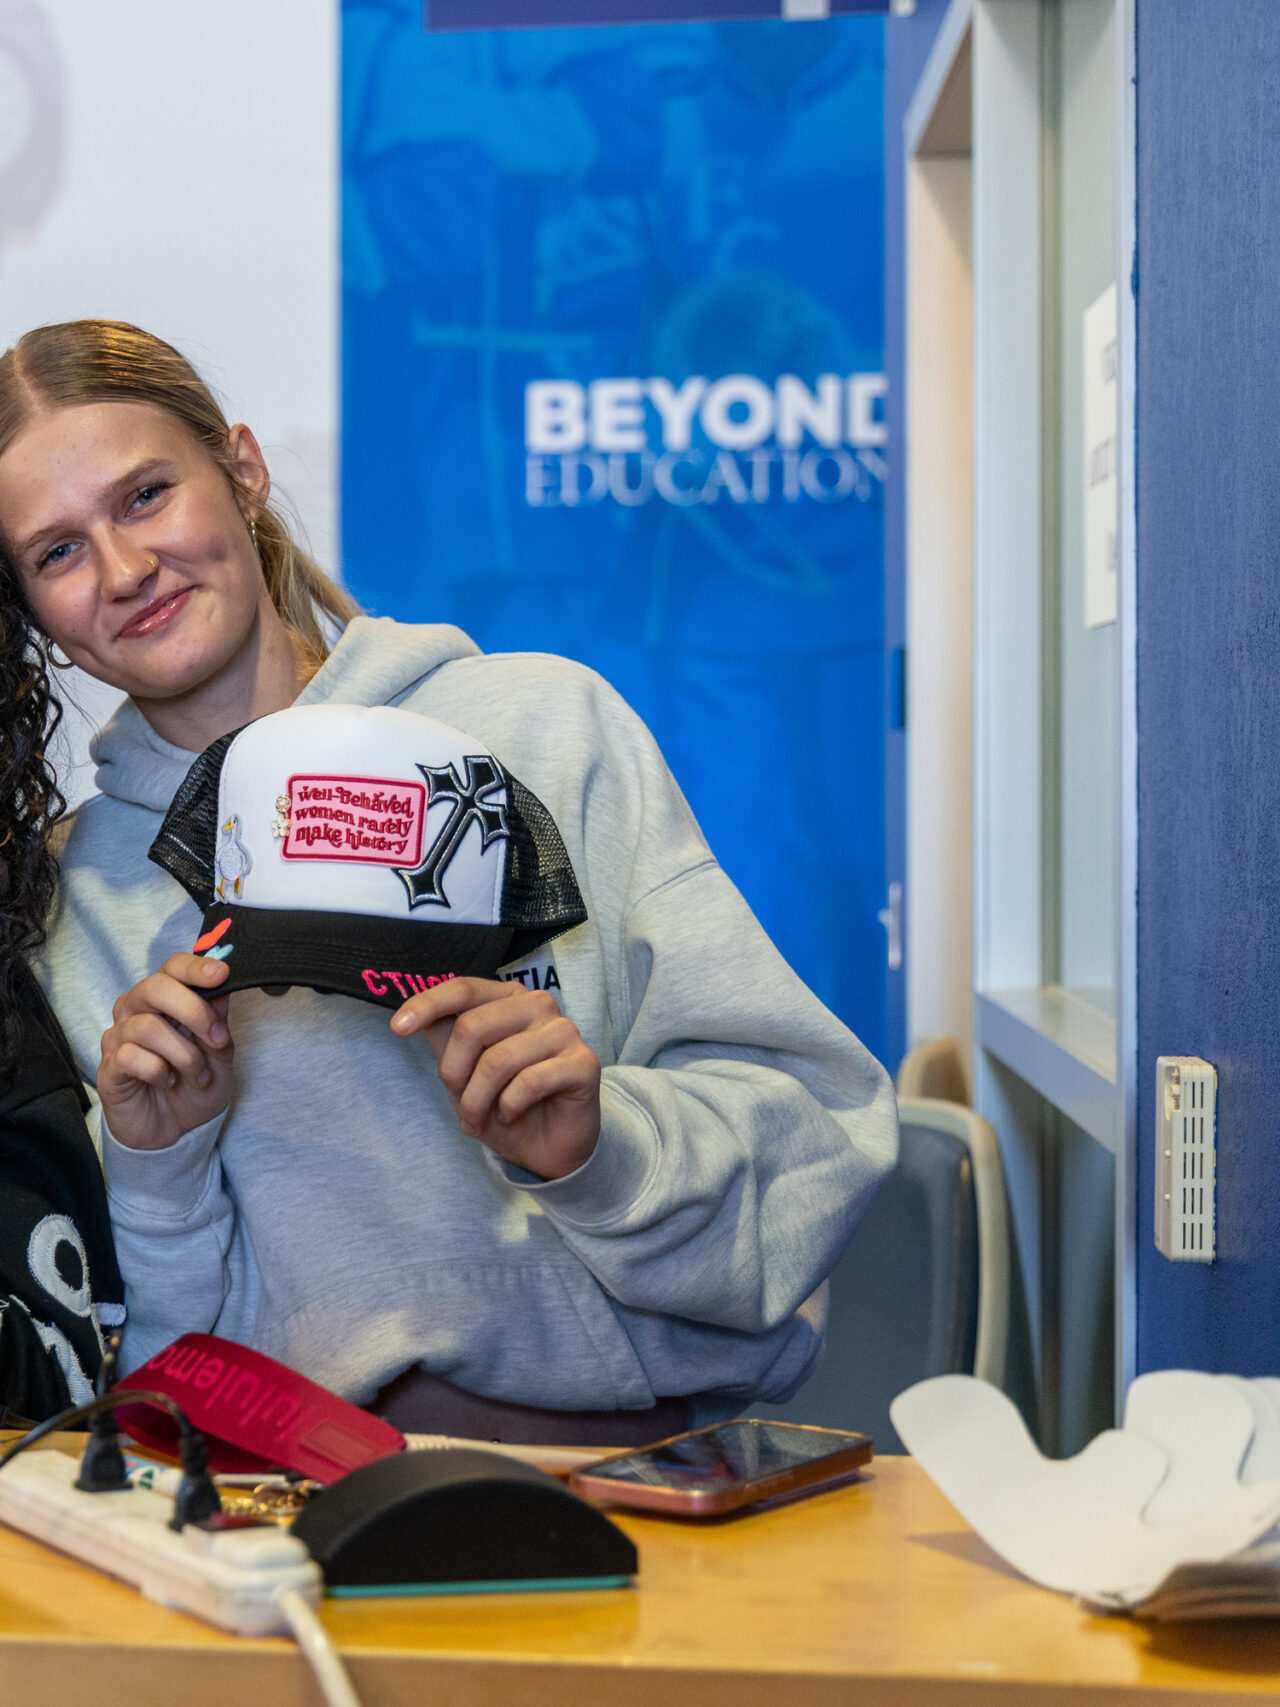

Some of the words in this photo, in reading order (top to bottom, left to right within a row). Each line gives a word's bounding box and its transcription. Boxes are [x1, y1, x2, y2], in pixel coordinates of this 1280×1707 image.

[295, 805, 355, 826] women
[358, 816, 414, 838] rarely
[294, 823, 344, 849] make
[345, 828, 409, 855] history
